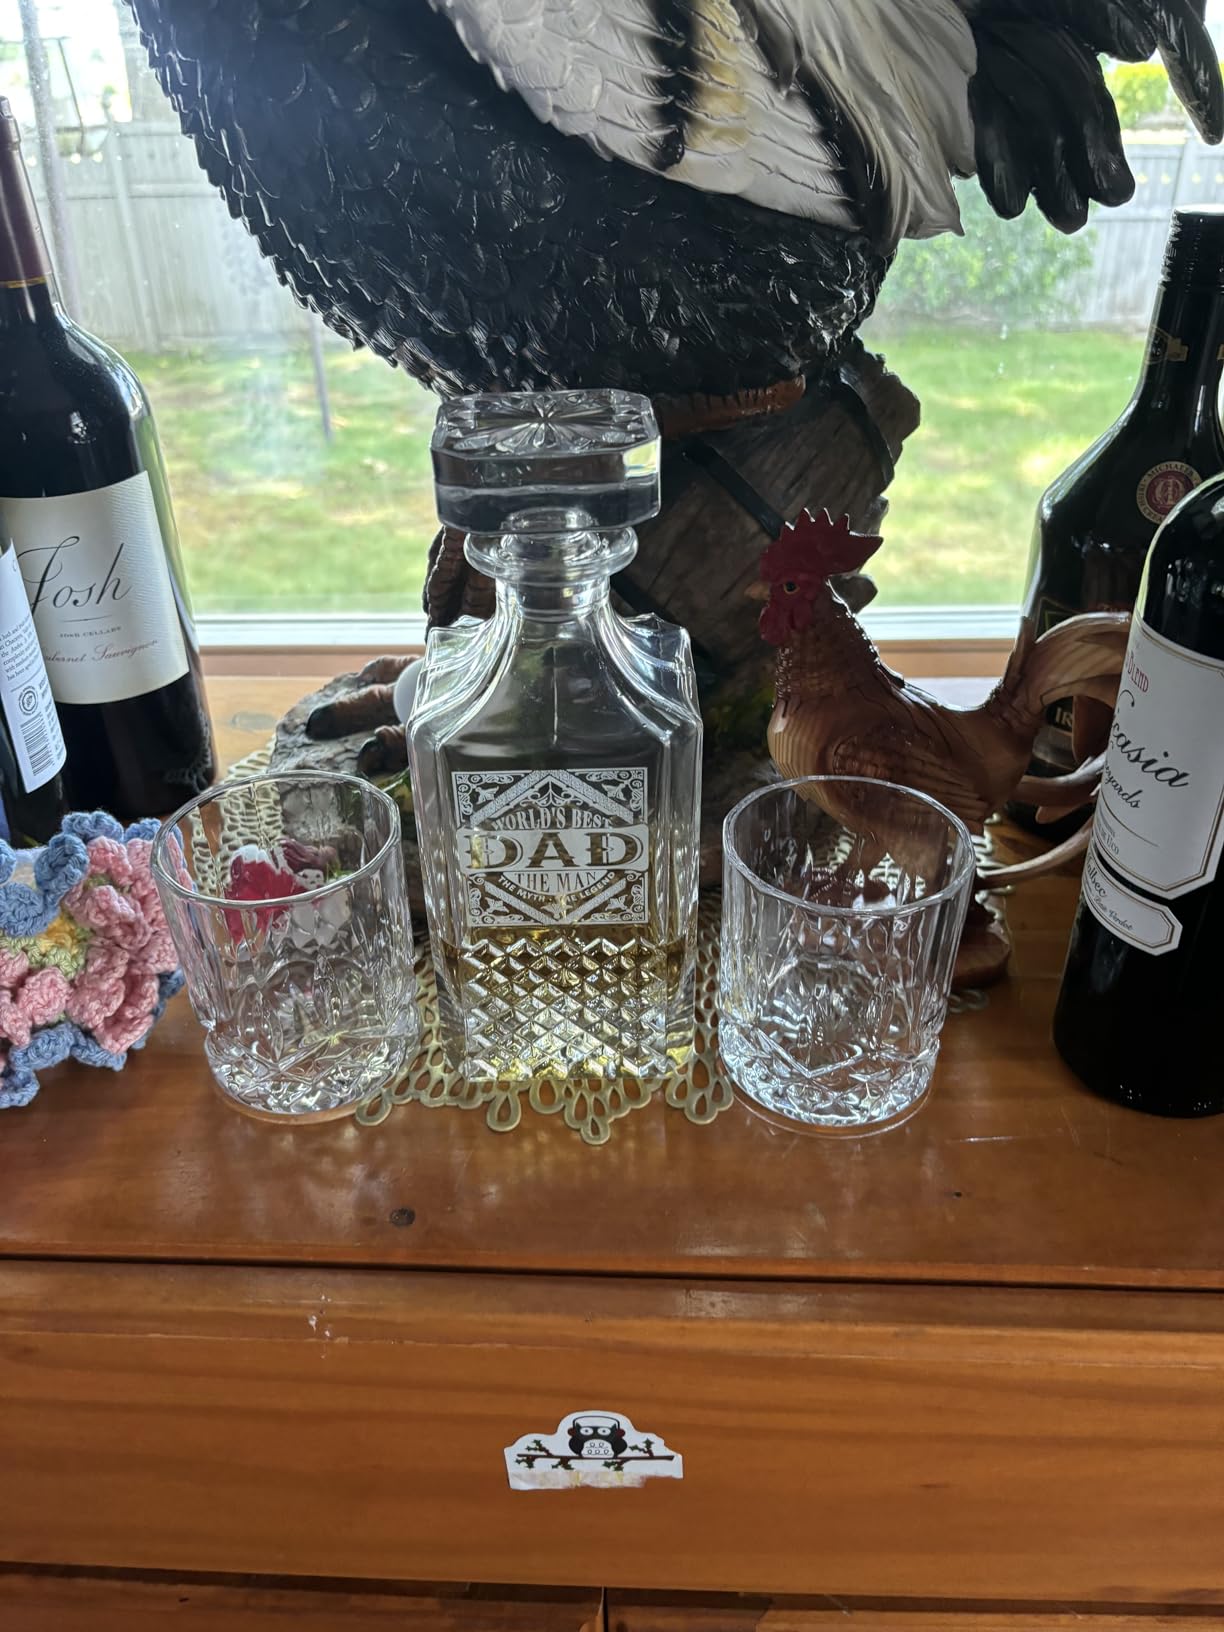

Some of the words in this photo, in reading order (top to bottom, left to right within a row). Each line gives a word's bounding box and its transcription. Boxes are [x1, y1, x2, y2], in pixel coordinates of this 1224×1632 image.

[17, 535, 132, 616] Josh
[1112, 690, 1190, 788] casia
[491, 807, 566, 831] WORLD'S
[572, 808, 613, 829] BEST
[464, 832, 645, 869] DAD
[498, 875, 516, 892] THE
[516, 889, 545, 902] MYTH
[579, 871, 617, 899] LEGEND
[515, 872, 551, 893] THE
[557, 871, 597, 893] MAN
